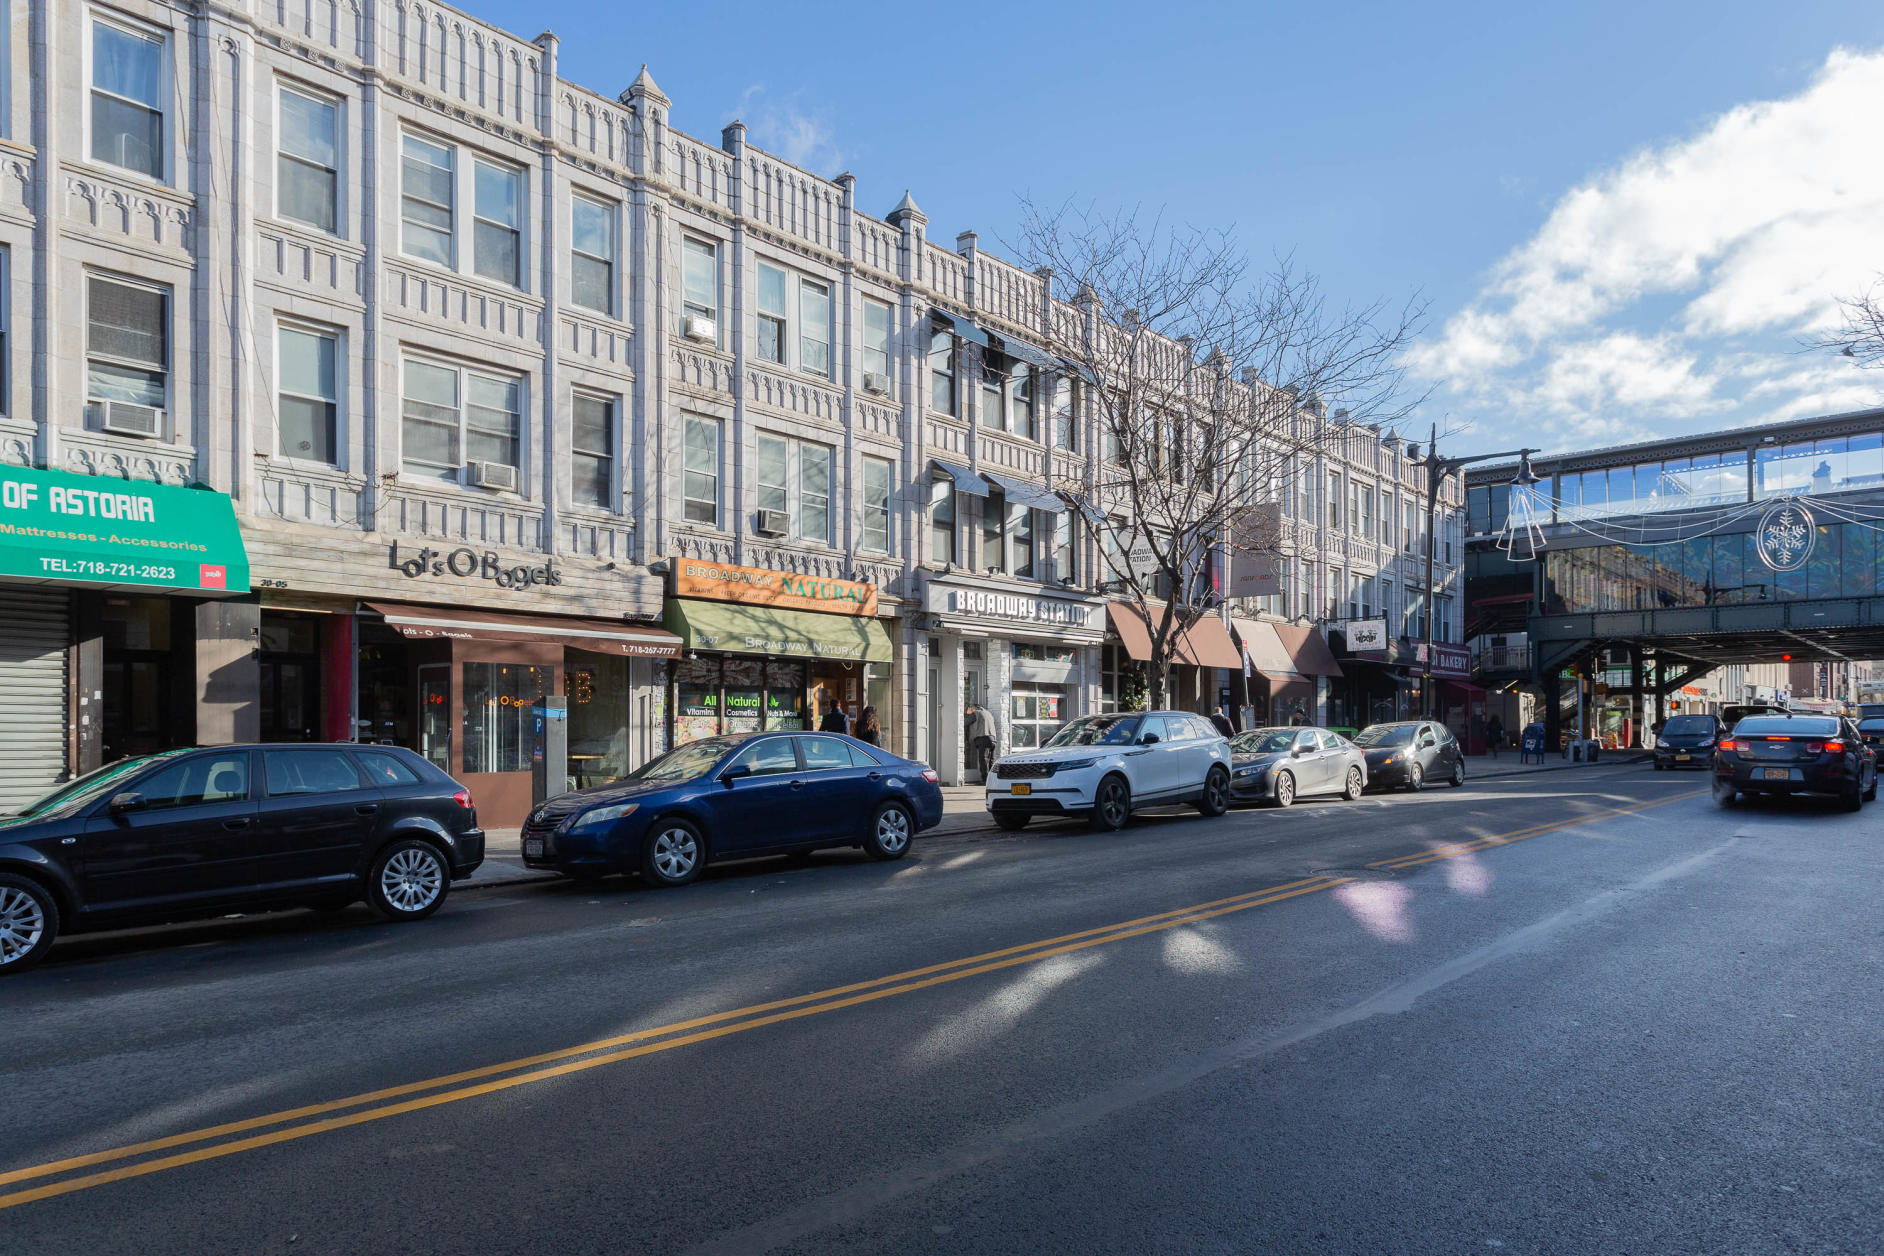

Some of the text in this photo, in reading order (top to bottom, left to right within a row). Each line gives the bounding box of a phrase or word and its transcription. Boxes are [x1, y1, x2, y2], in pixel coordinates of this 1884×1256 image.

[3, 480, 155, 523] OF ASTORIA
[0, 523, 98, 542] Mattresses
[109, 534, 207, 552] Accessories
[40, 557, 176, 580] TEL:718-721-2623
[447, 547, 478, 577] O
[482, 551, 562, 591] Bagels
[686, 564, 868, 605] BROADWAY NATURAL
[957, 591, 1091, 625] BROADWAY STATION
[629, 645, 676, 655] 718-267-7777
[695, 635, 719, 644] 30-07
[1441, 654, 1467, 670] BAKERY
[686, 708, 715, 716] Vitamins
[726, 709, 758, 717] Cosmetics
[704, 695, 760, 707] All Natural
